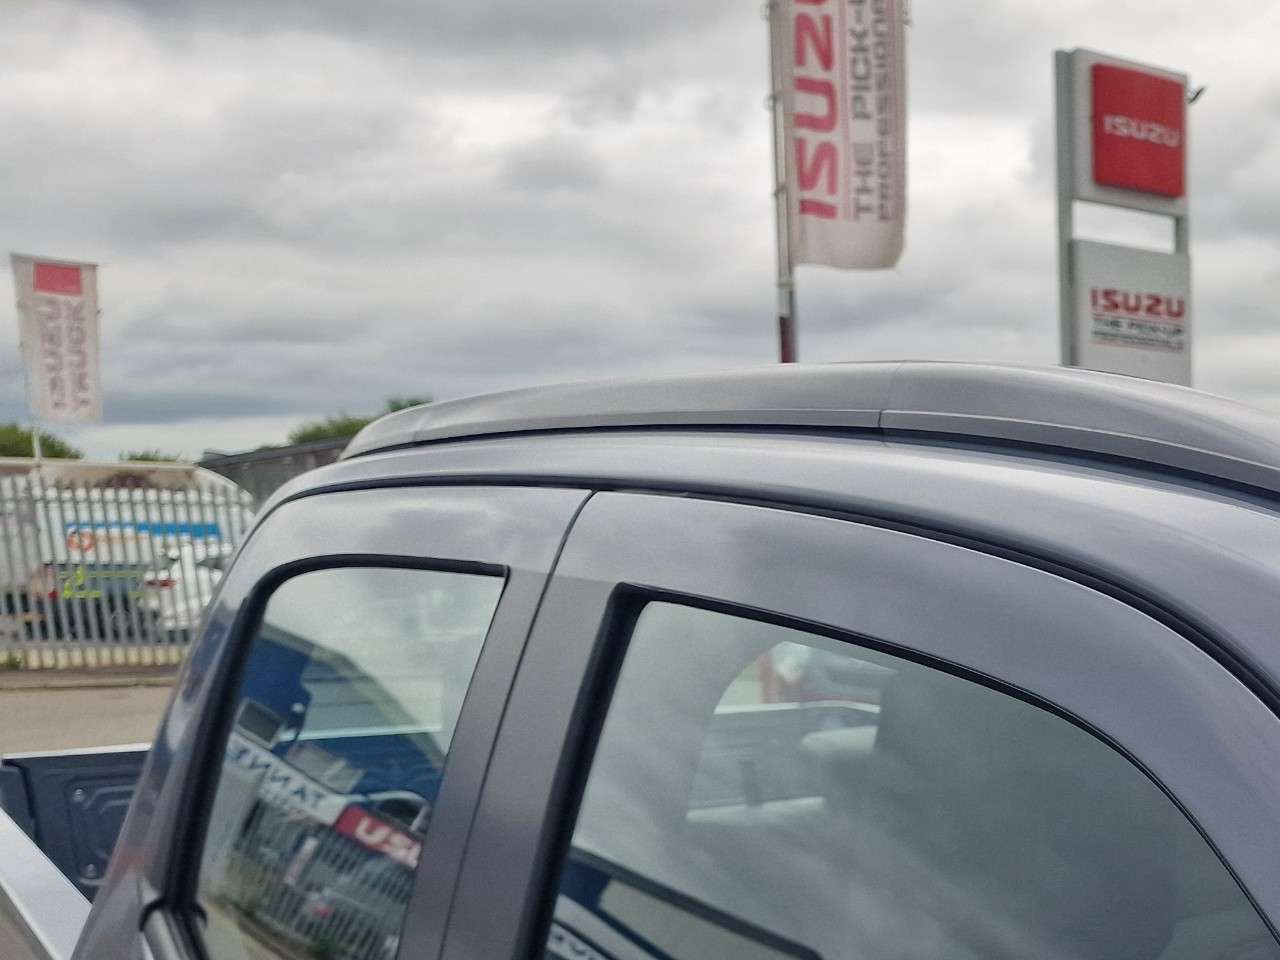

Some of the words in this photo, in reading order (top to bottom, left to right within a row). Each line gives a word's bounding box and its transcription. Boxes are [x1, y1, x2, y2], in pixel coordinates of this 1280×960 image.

[849, 0, 873, 120] PICK-
[793, 0, 838, 220] ISUZ
[1103, 114, 1181, 148] ISUZU
[1090, 288, 1184, 319] ISUZU
